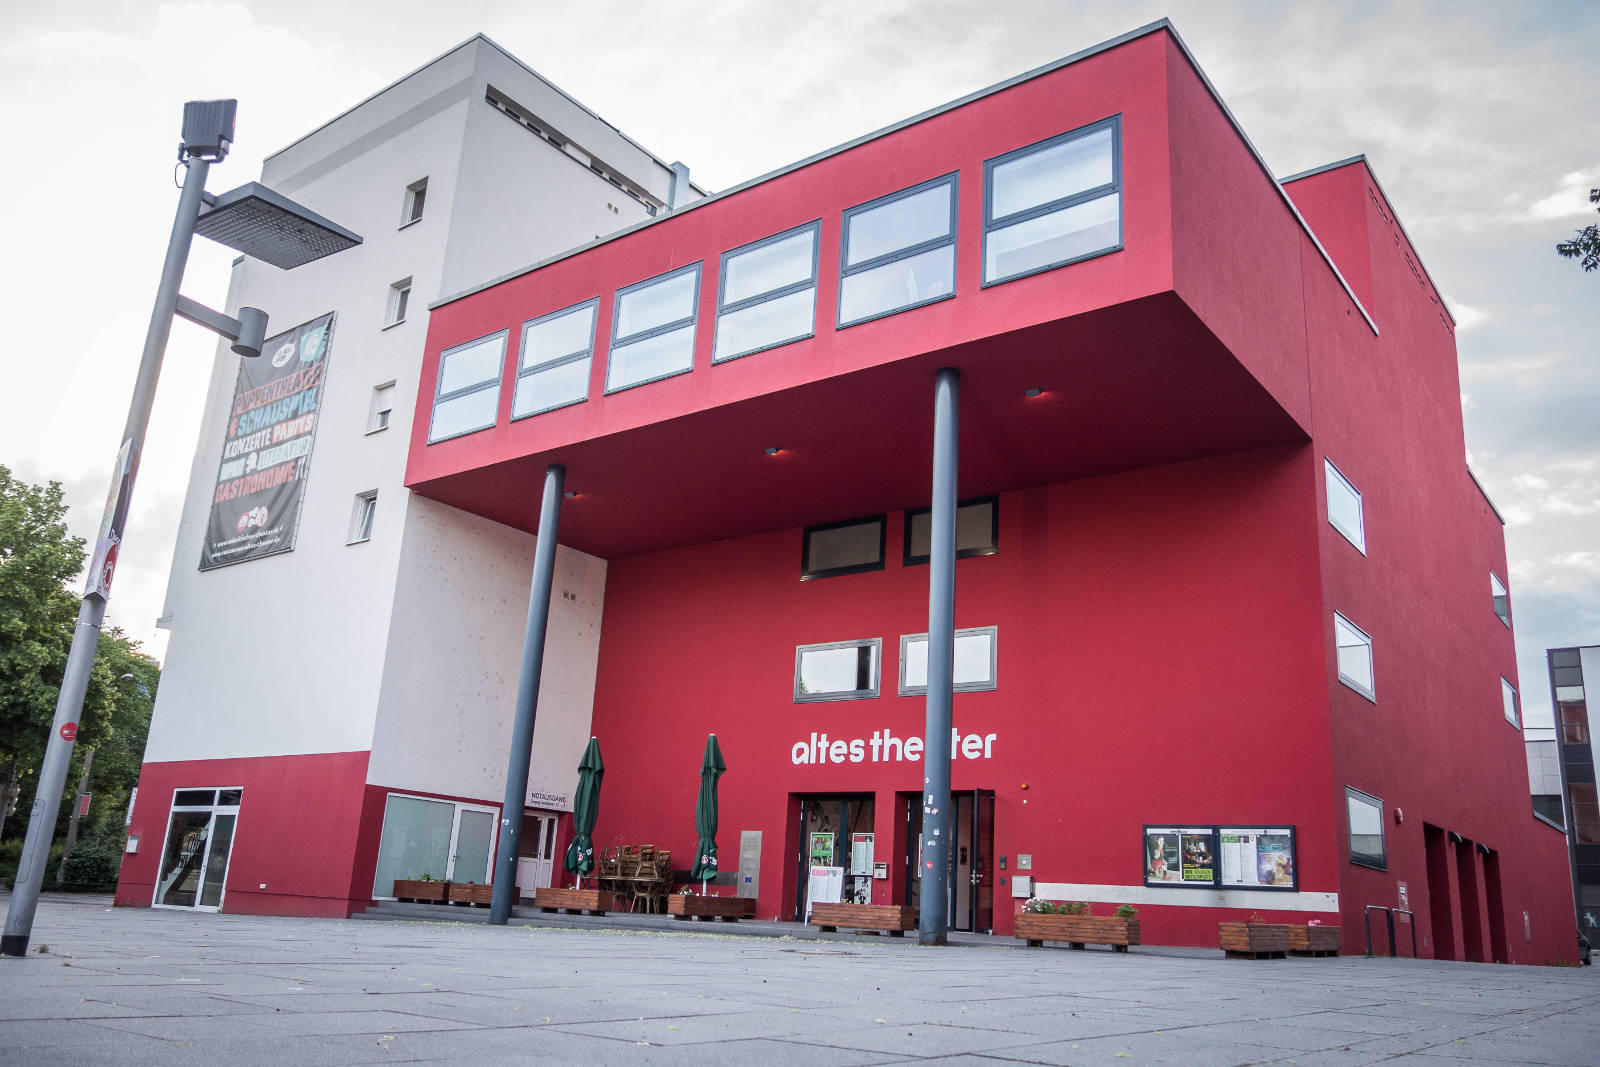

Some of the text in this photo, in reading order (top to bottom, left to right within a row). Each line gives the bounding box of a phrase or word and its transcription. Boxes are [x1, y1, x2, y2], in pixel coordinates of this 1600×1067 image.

[237, 387, 320, 436] SCHAUSPIEL
[224, 414, 314, 459] KONZERTE PARTYS
[215, 461, 297, 503] GASTRONOMIE
[791, 728, 997, 765] altes theter
[531, 792, 567, 804] NOTAUSGANG
